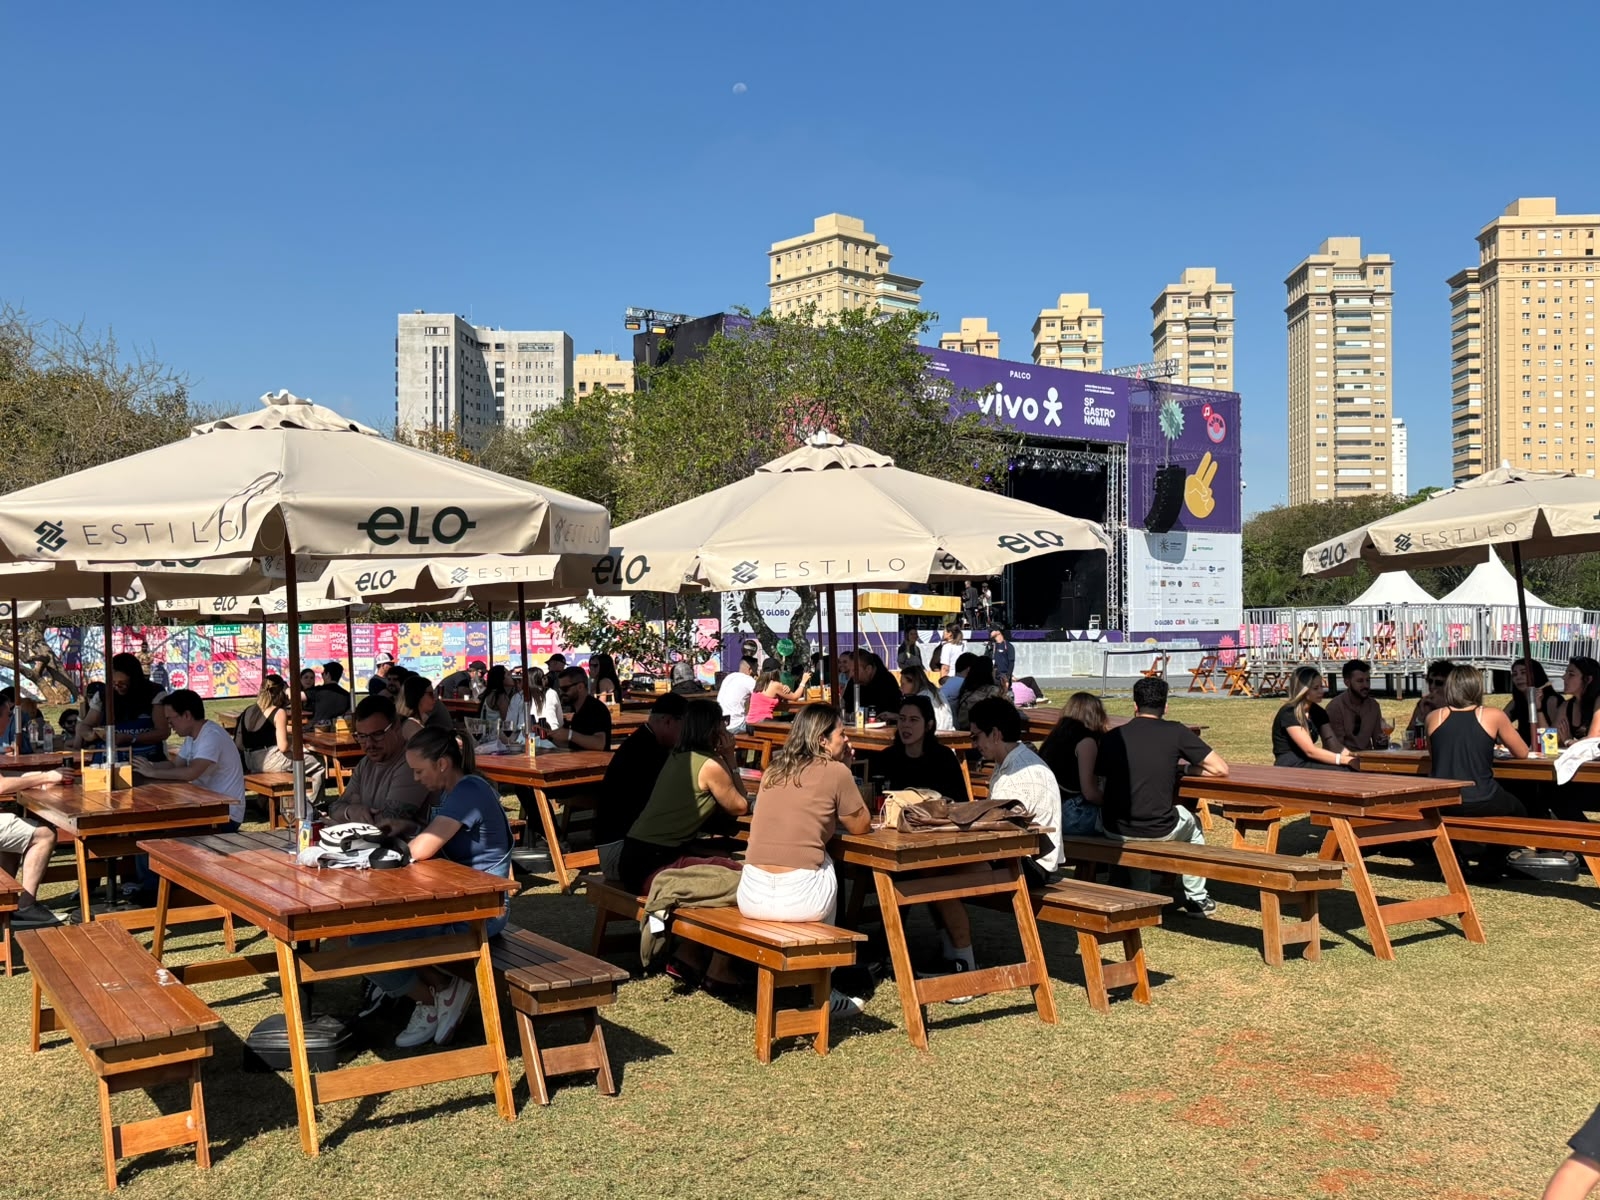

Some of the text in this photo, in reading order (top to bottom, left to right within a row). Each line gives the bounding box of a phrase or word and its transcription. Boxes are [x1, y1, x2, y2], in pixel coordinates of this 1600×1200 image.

[1009, 370, 1031, 380] PALCO
[977, 382, 1039, 421] vivo
[1083, 397, 1095, 407] SP
[1083, 406, 1116, 419] GASTRO
[1084, 416, 1110, 427] NOMIA
[83, 520, 240, 545] ESTILO
[1422, 522, 1517, 546] ESTILO
[478, 565, 556, 579] ESTIL
[775, 557, 906, 578] ESTILO
